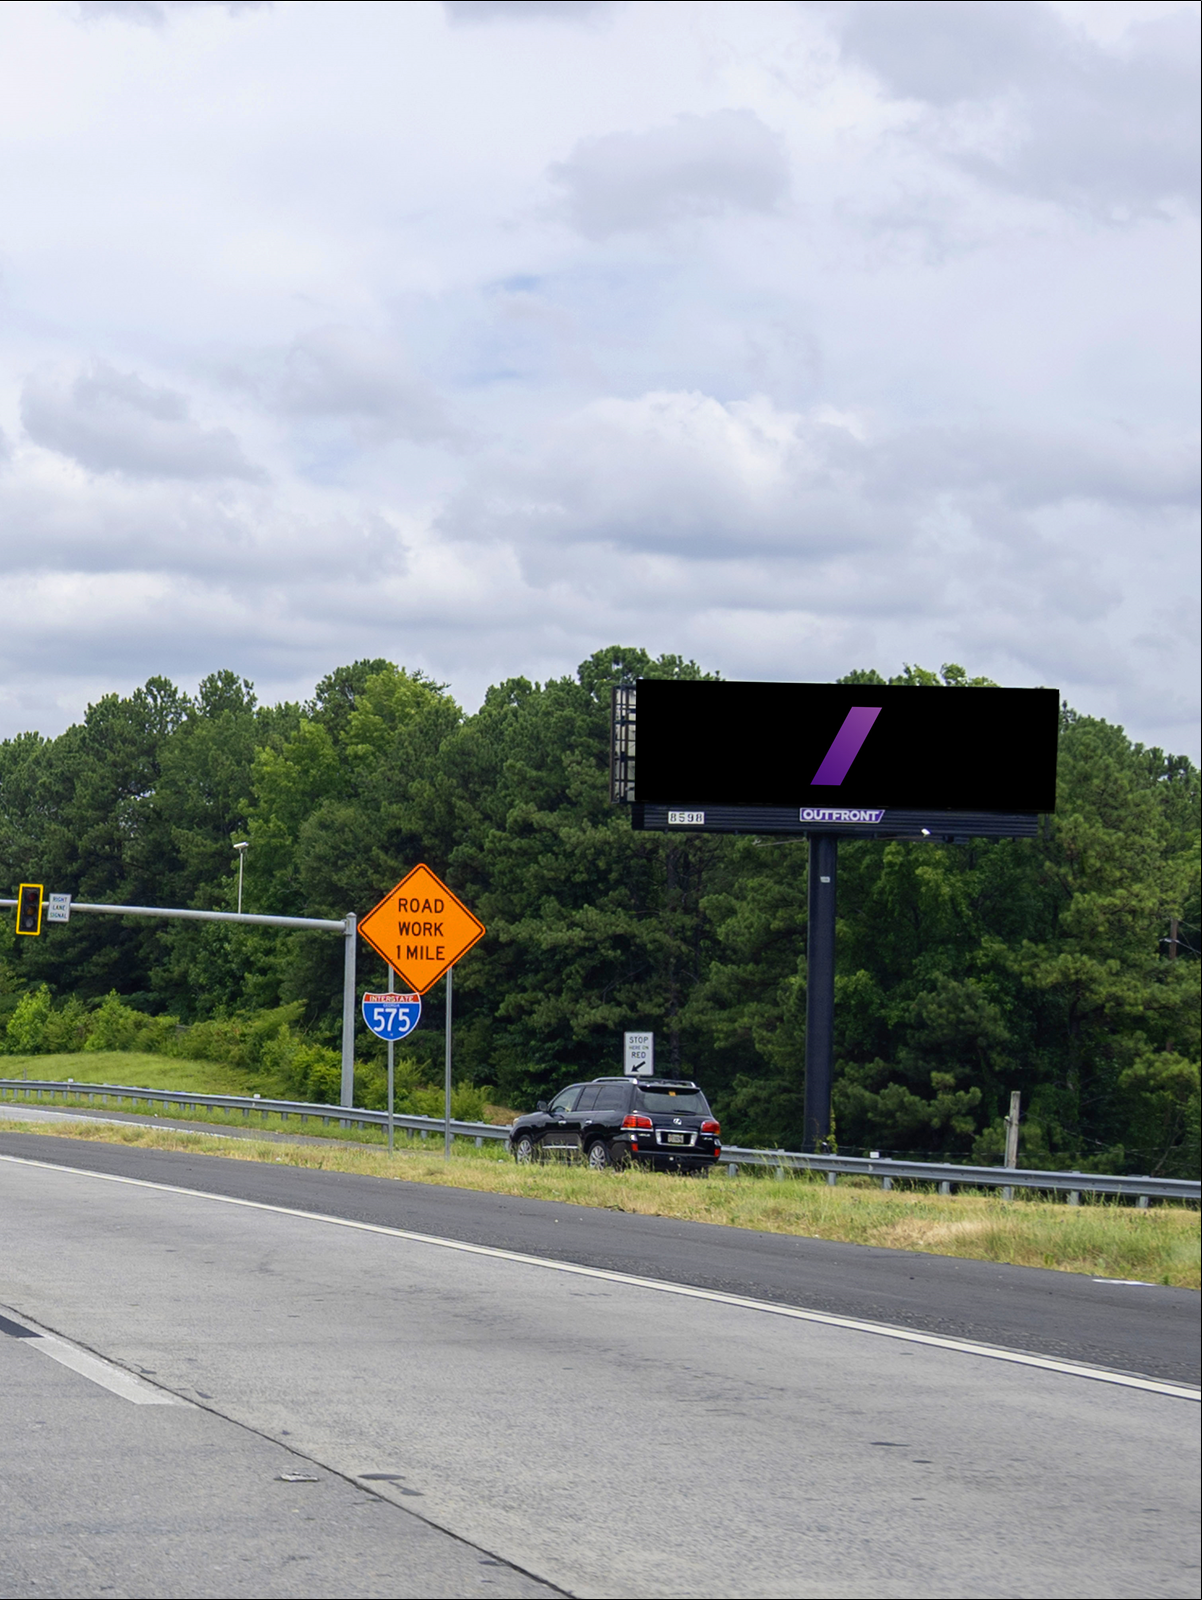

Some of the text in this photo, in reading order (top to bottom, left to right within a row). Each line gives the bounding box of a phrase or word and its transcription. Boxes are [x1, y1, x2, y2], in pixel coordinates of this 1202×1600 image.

[670, 812, 703, 822] 8598
[802, 808, 880, 821] OUTFRONT
[398, 898, 445, 914] ROAD
[49, 912, 68, 920] SIGNAL
[398, 921, 444, 937] WORK
[396, 944, 446, 961] 1 MILE
[369, 995, 414, 1003] INTERSTATE
[373, 1008, 411, 1032] 575
[629, 1036, 649, 1044] STOP
[631, 1051, 647, 1059] RED
